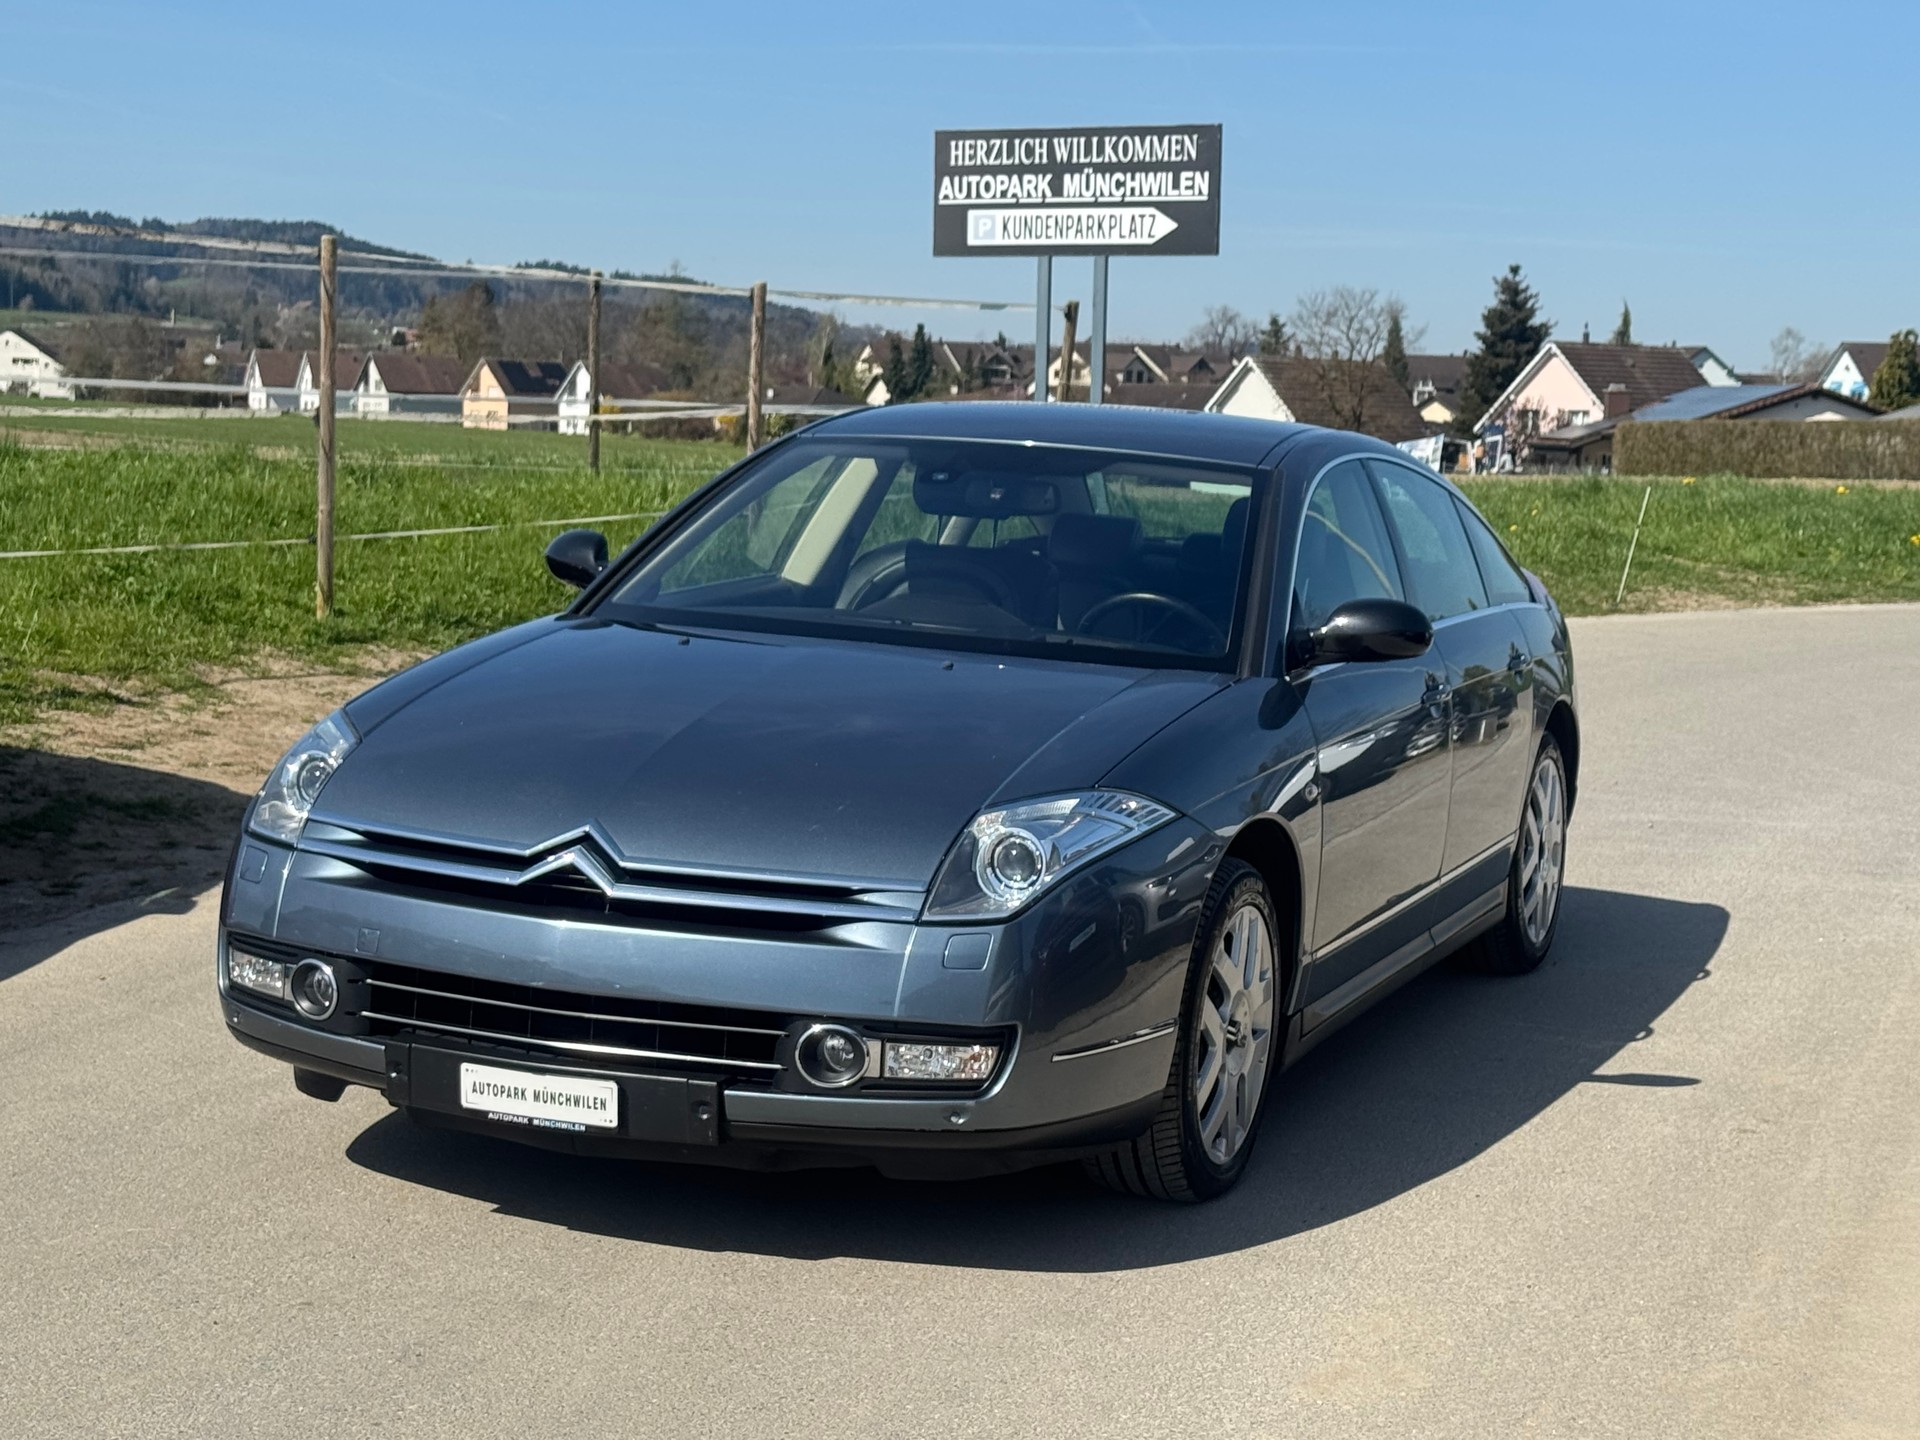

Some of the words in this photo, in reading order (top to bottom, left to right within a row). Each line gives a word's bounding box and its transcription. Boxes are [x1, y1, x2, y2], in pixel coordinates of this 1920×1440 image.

[950, 137, 1048, 166] HERZLICH
[1053, 134, 1198, 164] WILLKOMMEN
[938, 173, 1052, 199] AUTOPARK
[1063, 168, 1210, 198] MÜNCHWILEN
[978, 218, 992, 238] P
[1002, 214, 1156, 240] KUNDENPARKPLATZ
[471, 1080, 527, 1101] AUTOPARK
[533, 1086, 607, 1111] MÜNCHWILEN
[487, 1112, 529, 1125] AUTOPARK
[533, 1117, 586, 1132] MÜNCHWILEN
